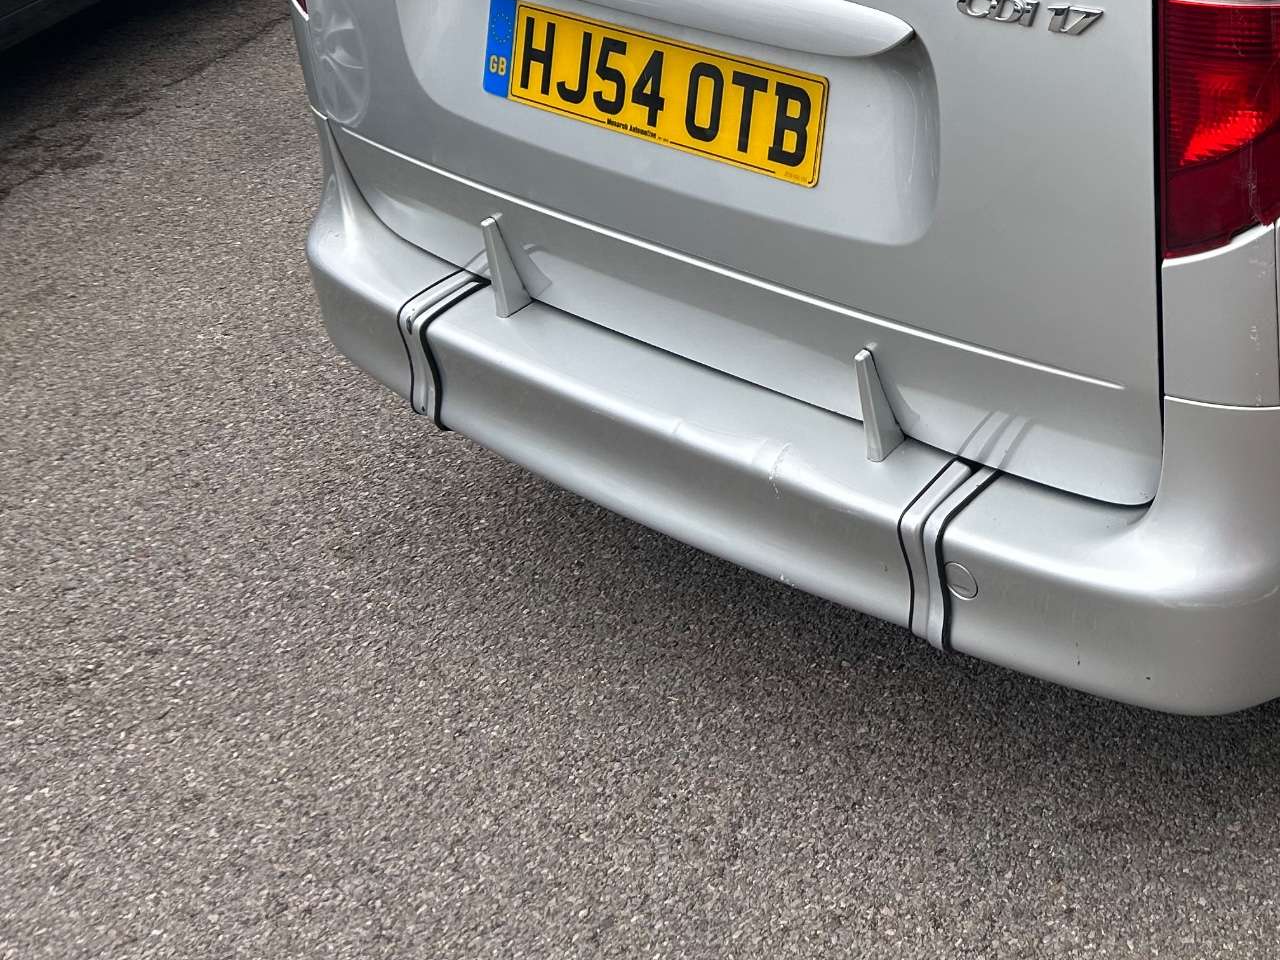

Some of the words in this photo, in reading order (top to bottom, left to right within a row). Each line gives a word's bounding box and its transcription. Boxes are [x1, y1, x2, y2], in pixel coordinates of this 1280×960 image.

[490, 54, 506, 76] GB
[520, 16, 666, 128] HJ54
[684, 61, 812, 168] OTB
